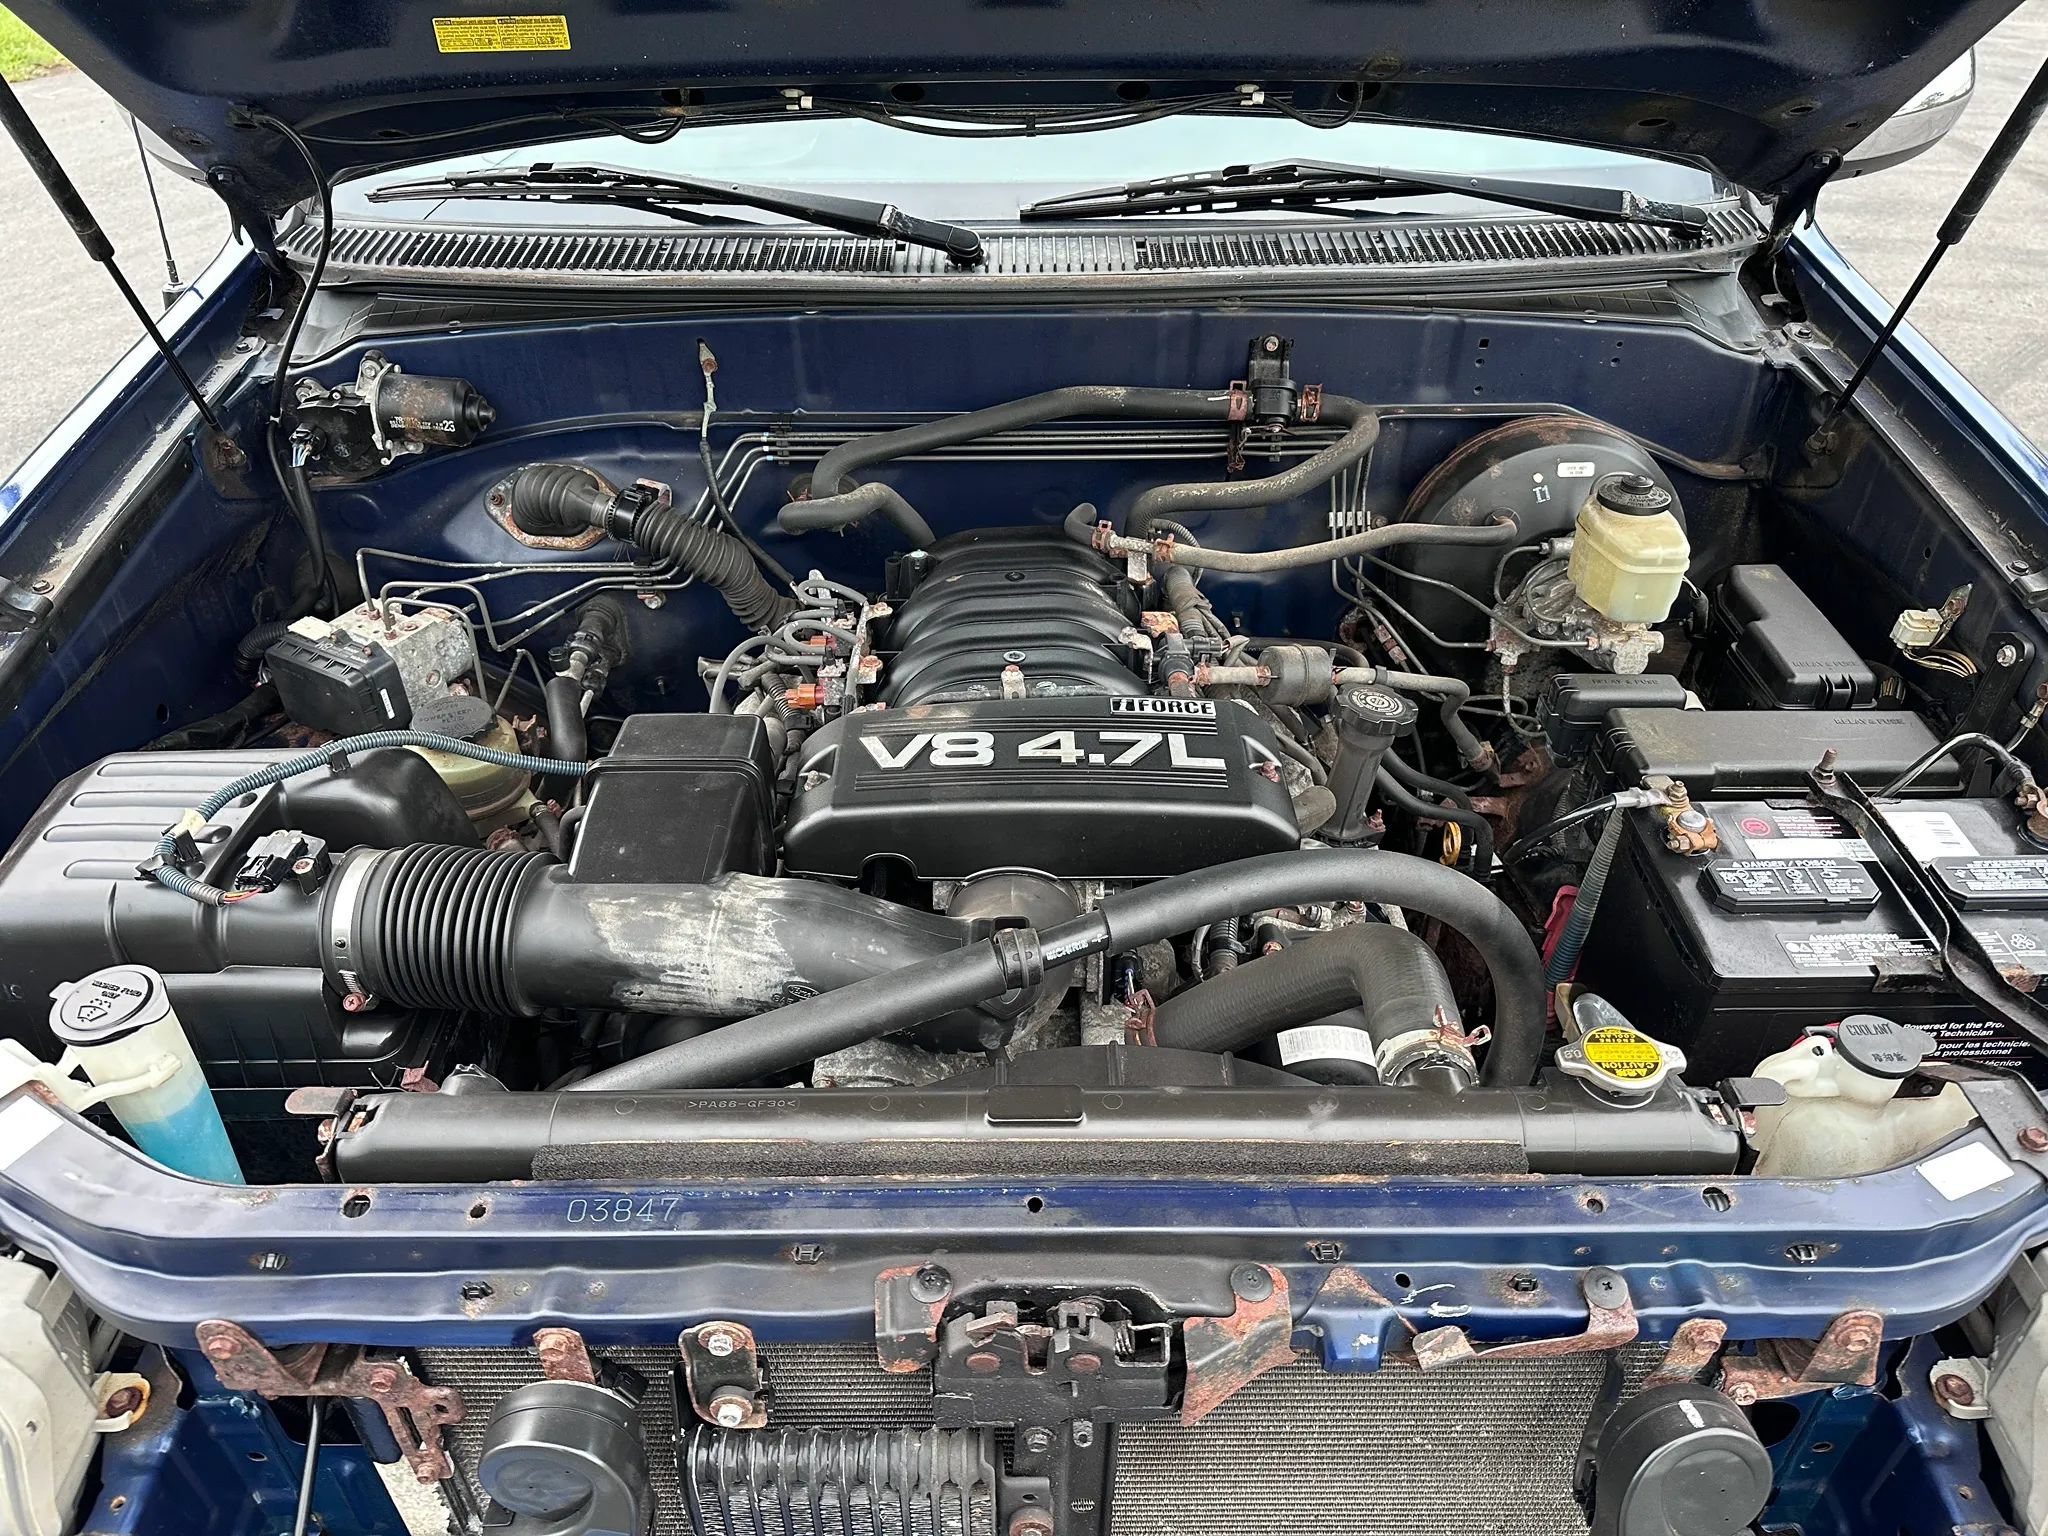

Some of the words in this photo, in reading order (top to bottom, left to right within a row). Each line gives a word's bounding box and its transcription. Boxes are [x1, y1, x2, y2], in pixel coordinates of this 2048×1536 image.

[858, 731, 996, 771] V8
[1018, 730, 1228, 771] 4.7L
[1742, 860, 1787, 869] DANGER
[1796, 859, 1837, 868] POISON
[1845, 1022, 1894, 1037] COOLANT
[1948, 1022, 1964, 1030] for
[1965, 1021, 1983, 1029] the
[1940, 1029, 1994, 1038] Technician
[1938, 1042, 1963, 1051] pour
[1964, 1041, 1981, 1049] les
[1941, 1047, 2013, 1057] professionnel
[1602, 1061, 1655, 1069] CAUTION
[566, 1197, 680, 1224] 03847
